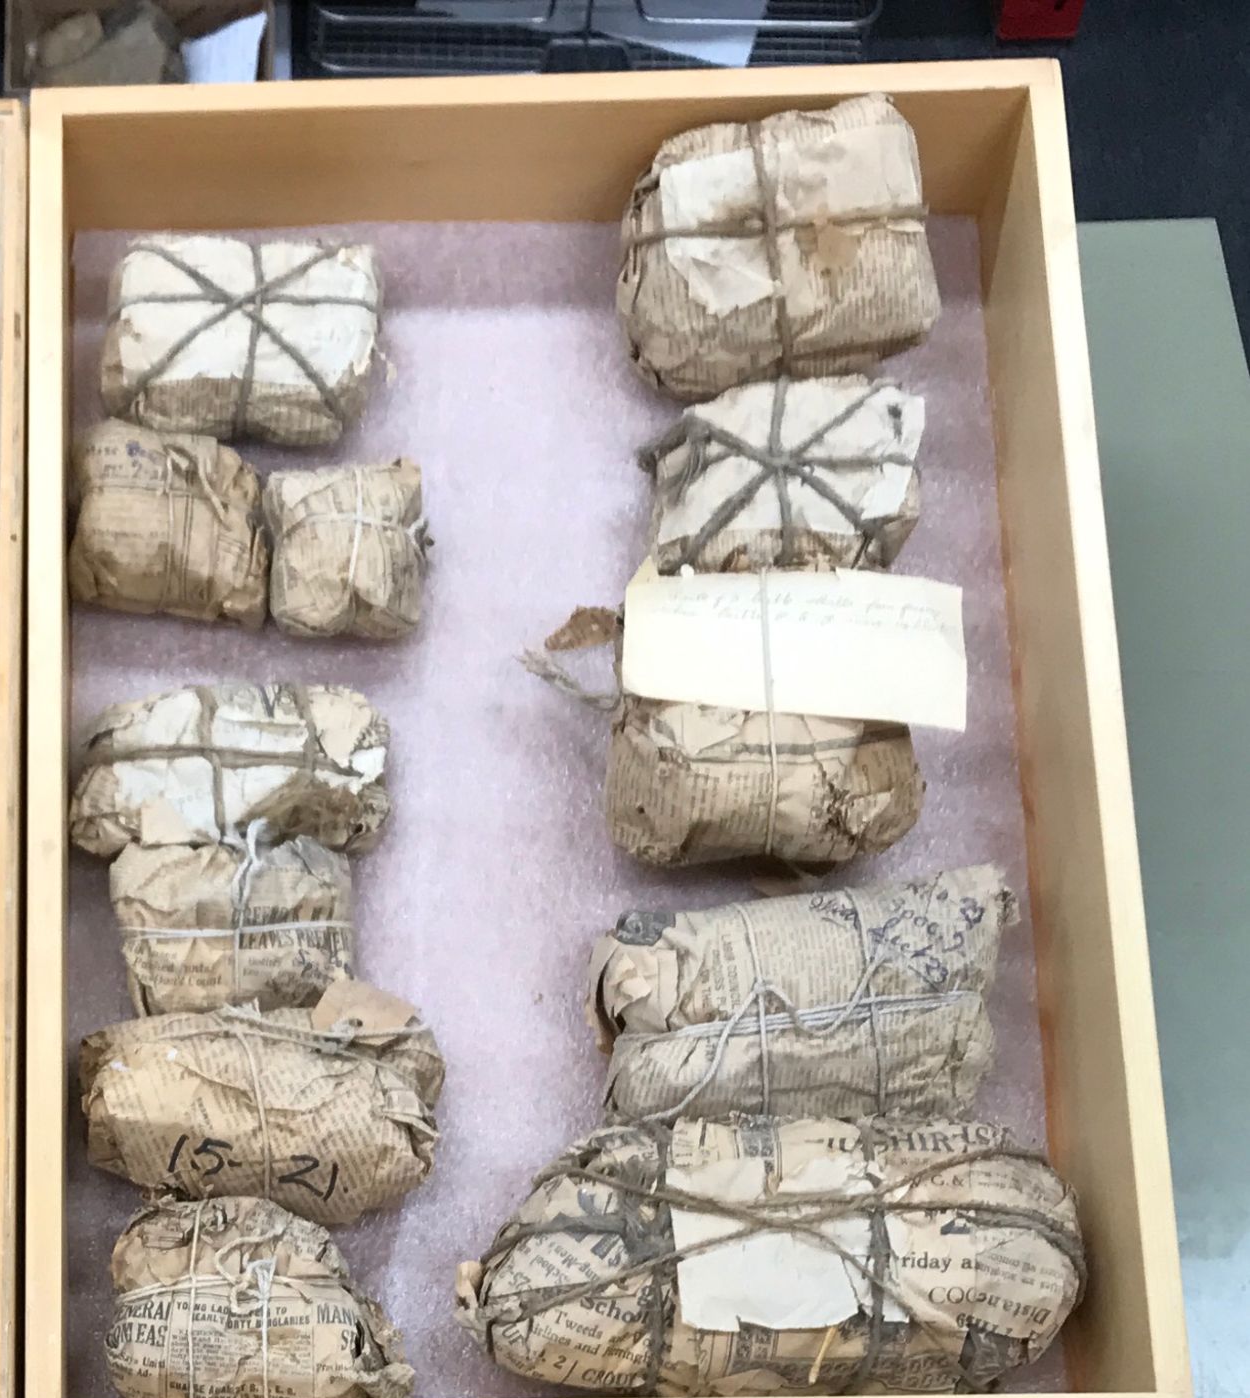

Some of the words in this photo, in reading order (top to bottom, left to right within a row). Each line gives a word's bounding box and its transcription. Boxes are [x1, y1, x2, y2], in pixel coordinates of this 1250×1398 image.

[886, 1250, 953, 1274] riday
[136, 1322, 169, 1348] EAS
[554, 1309, 604, 1340] Tweeds
